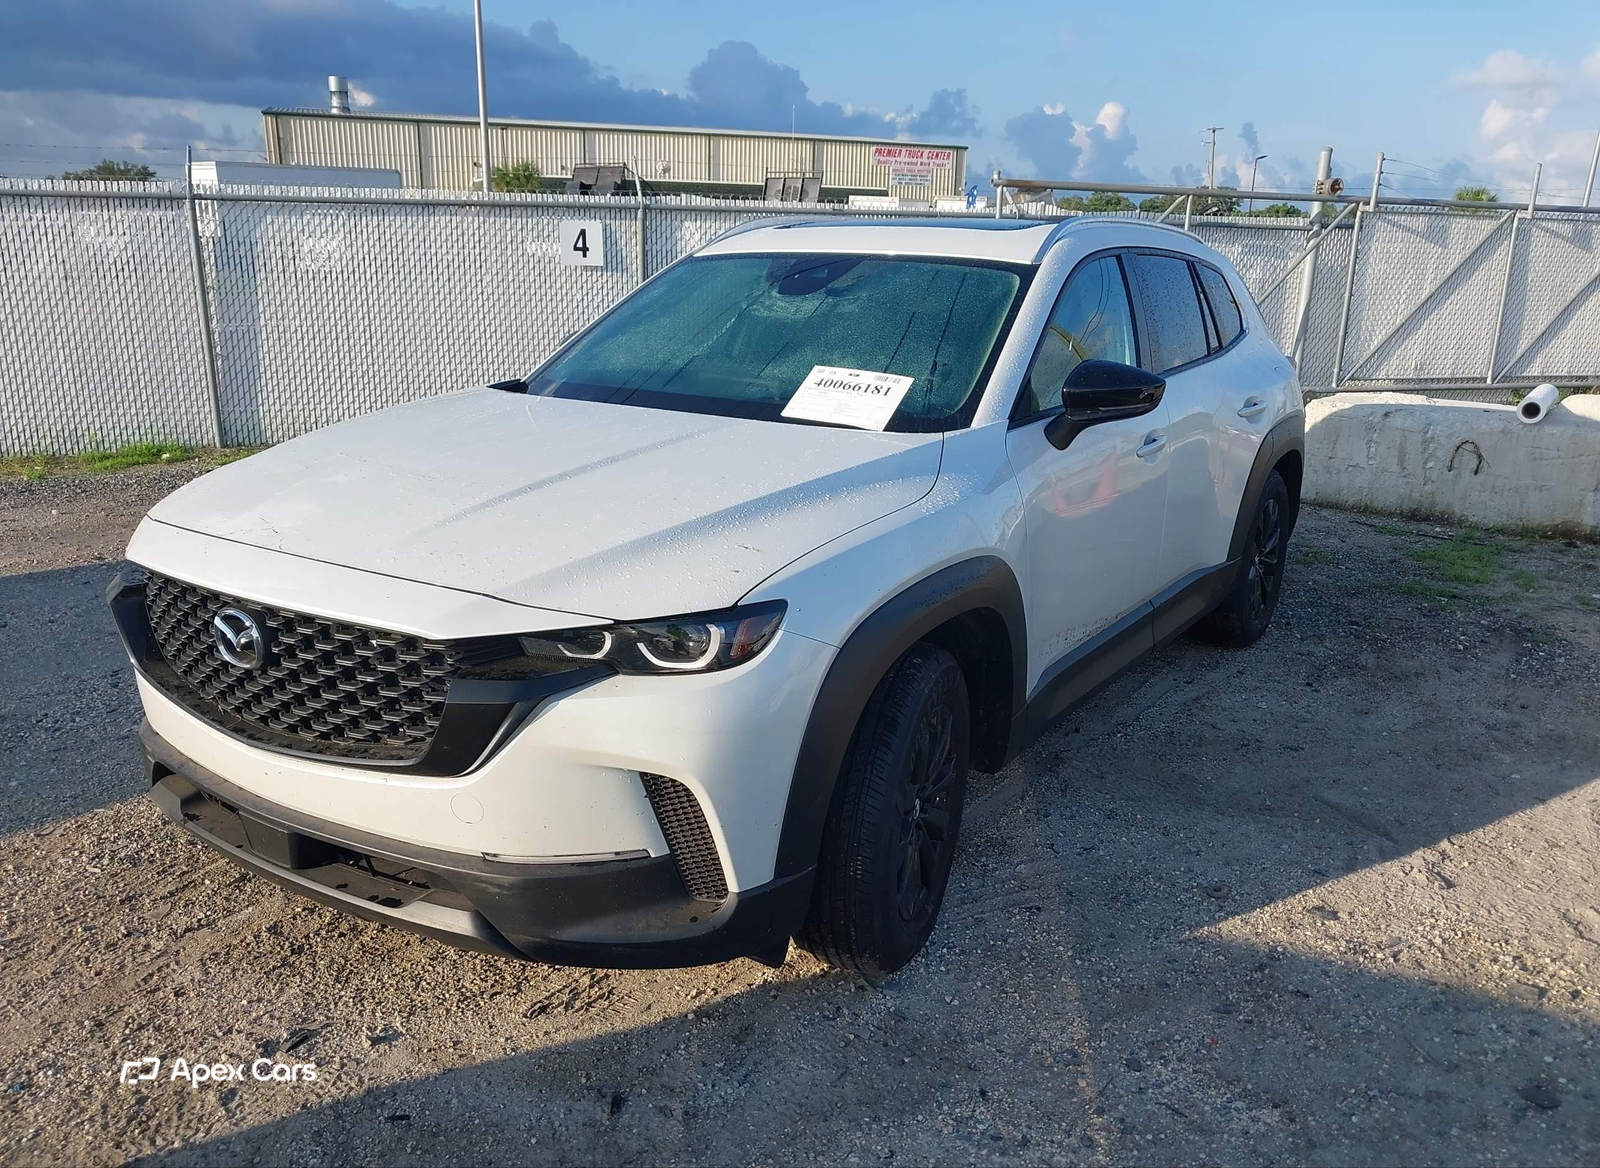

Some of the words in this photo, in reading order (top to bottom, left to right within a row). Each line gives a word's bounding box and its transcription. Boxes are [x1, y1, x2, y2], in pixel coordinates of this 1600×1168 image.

[874, 148, 903, 158] PREMIER
[904, 149, 925, 159] TRUCK
[927, 150, 952, 161] CENTER
[573, 228, 590, 258] 4
[813, 377, 892, 397] 40066181
